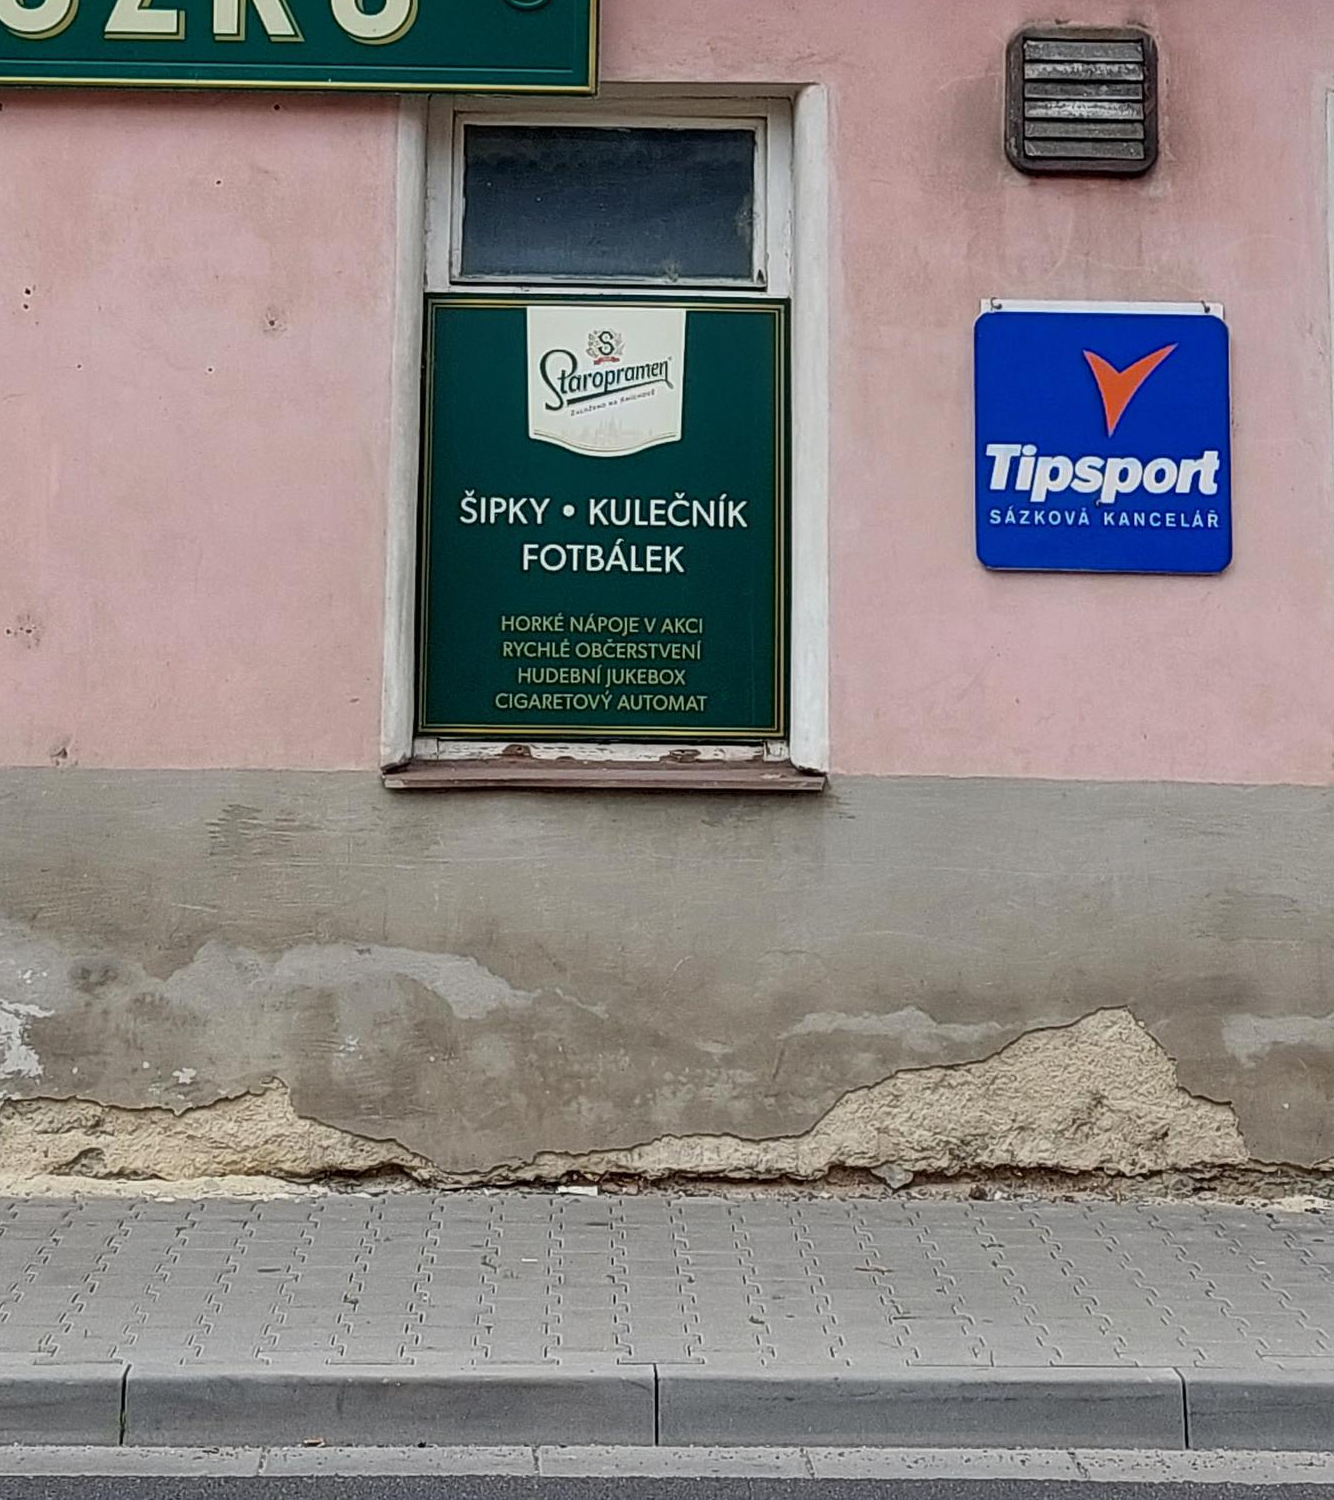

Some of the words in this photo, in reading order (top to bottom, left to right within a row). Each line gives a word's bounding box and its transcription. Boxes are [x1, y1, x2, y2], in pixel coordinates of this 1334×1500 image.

[539, 349, 674, 411] Staropramen
[986, 444, 1220, 504] Tipsport
[460, 489, 551, 524] ŠIPKY
[589, 492, 748, 528] KULEČNÍK
[989, 504, 1090, 526] SÁZKOVÁ
[1103, 509, 1219, 529] KANCELÁŘ
[522, 538, 685, 573] FOTBÁLEK
[501, 612, 565, 632] HORKÉ
[569, 613, 640, 637] NÁPOJE
[644, 618, 657, 633] V
[660, 618, 703, 634] AKCI
[502, 638, 571, 658] RYCHLÉ
[575, 638, 701, 660] OBČERSTVENÍ
[517, 664, 602, 684] HUDEBNÍ
[605, 668, 686, 688] JUKEBOX
[494, 689, 613, 710] CIGARETOVÝ
[616, 695, 708, 712] AUTOMAT
